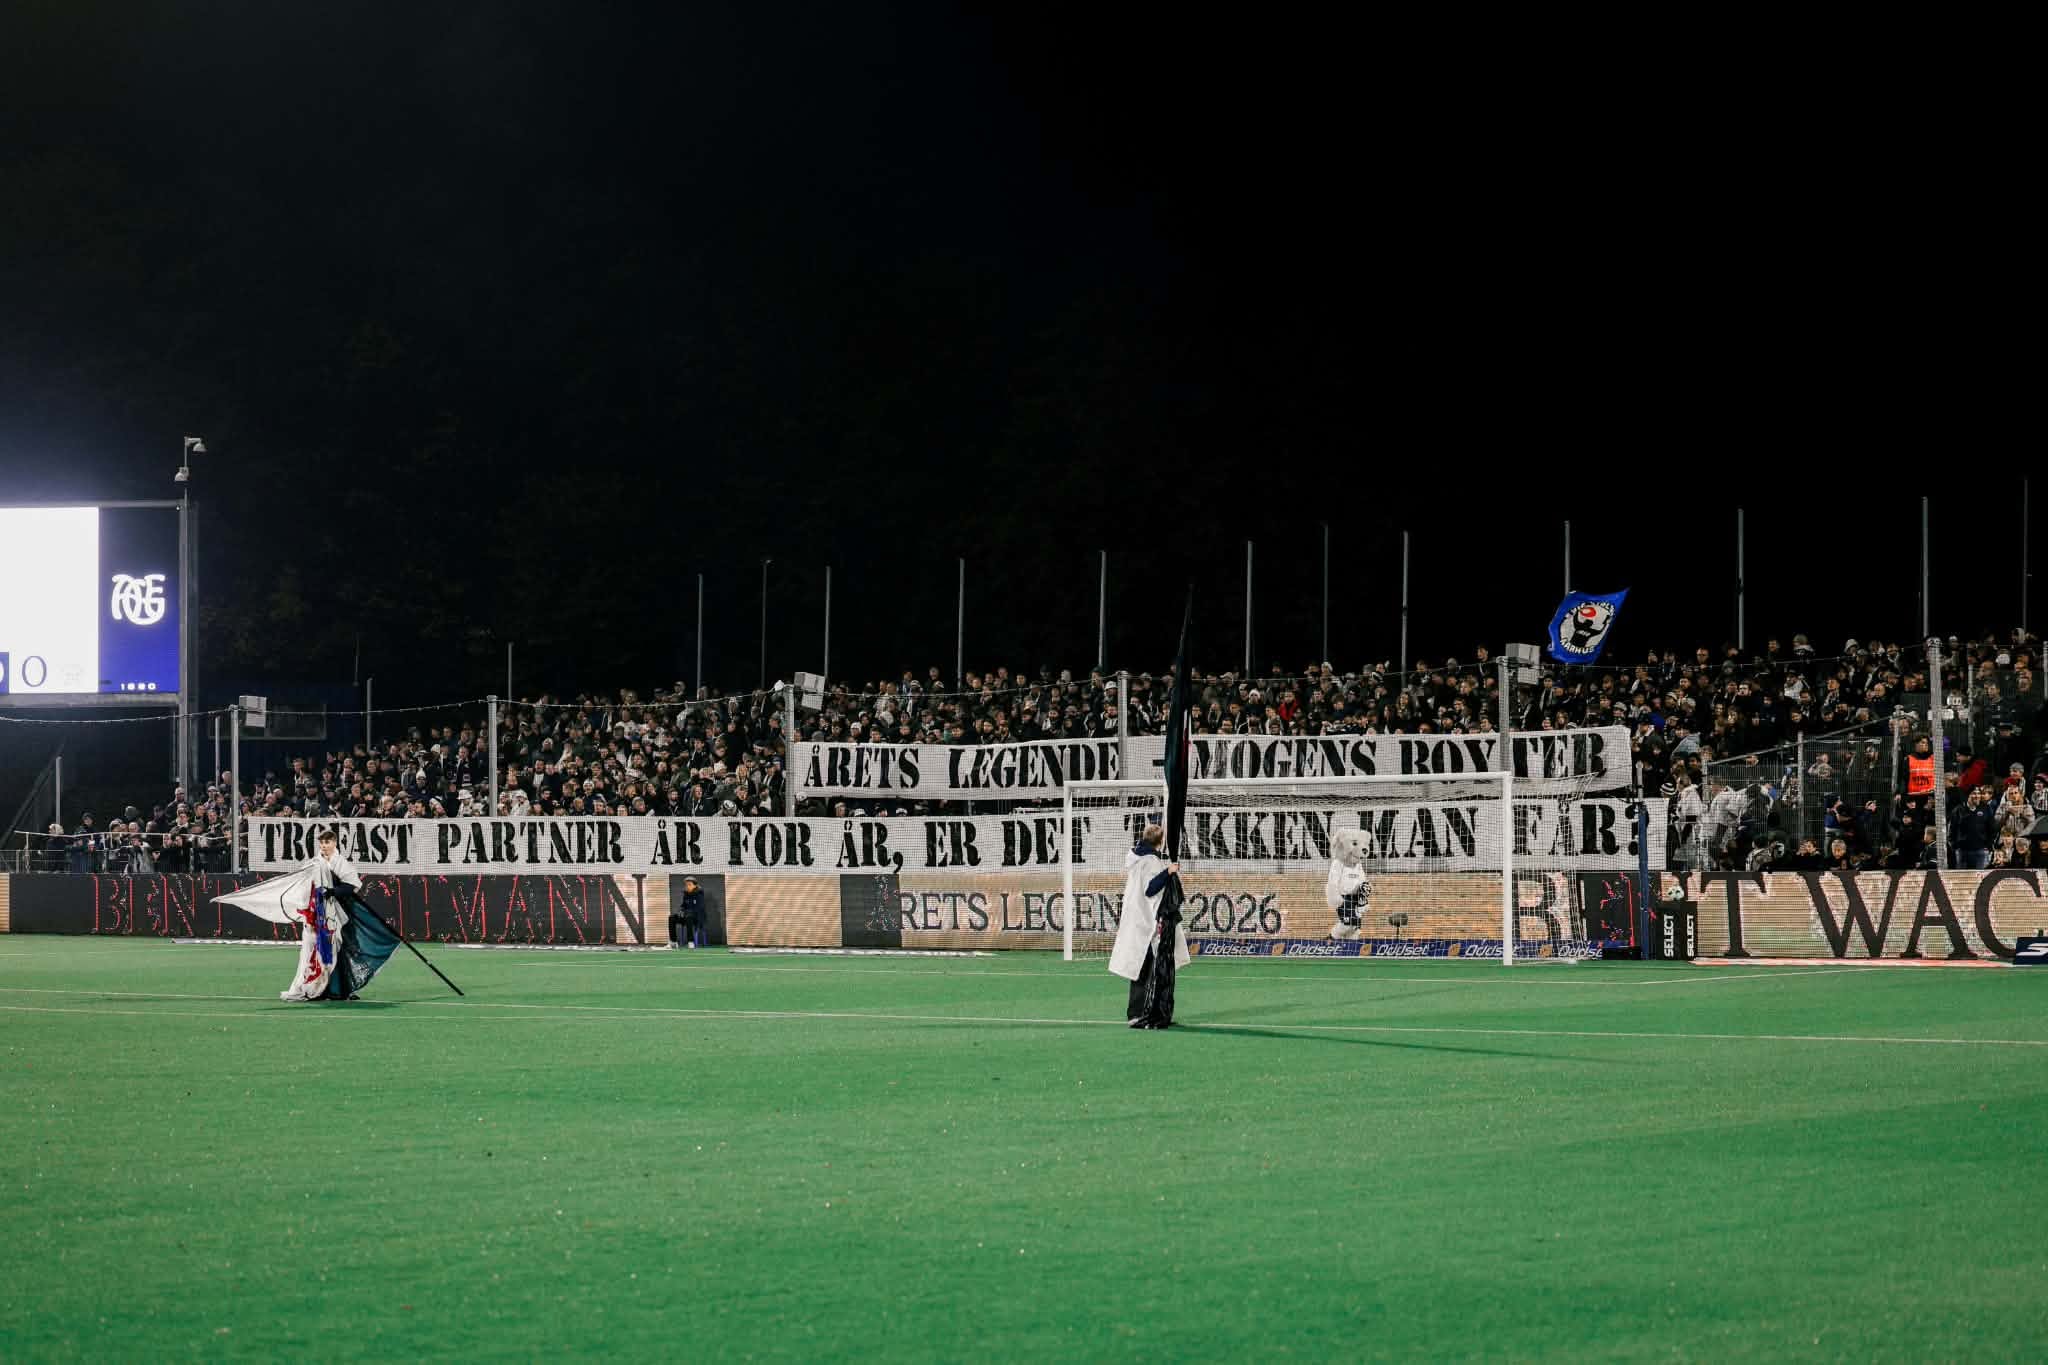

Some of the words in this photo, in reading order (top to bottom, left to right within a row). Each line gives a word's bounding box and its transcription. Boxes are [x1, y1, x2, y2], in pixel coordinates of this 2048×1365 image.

[804, 744, 919, 788] ÅRETS
[949, 742, 1120, 788] LEGENDE
[1193, 739, 1376, 779] MOGENS
[437, 821, 624, 864] PARTNER
[651, 819, 703, 865] ÅR
[728, 821, 814, 867] FOR
[836, 820, 904, 873] ÅR,
[925, 822, 981, 867] ER
[1001, 817, 1091, 867] DET
[1357, 806, 1480, 860] MAN
[1189, 892, 1282, 934] 2026
[1288, 942, 1343, 956] Oddset
[1663, 914, 1675, 958] SELECT
